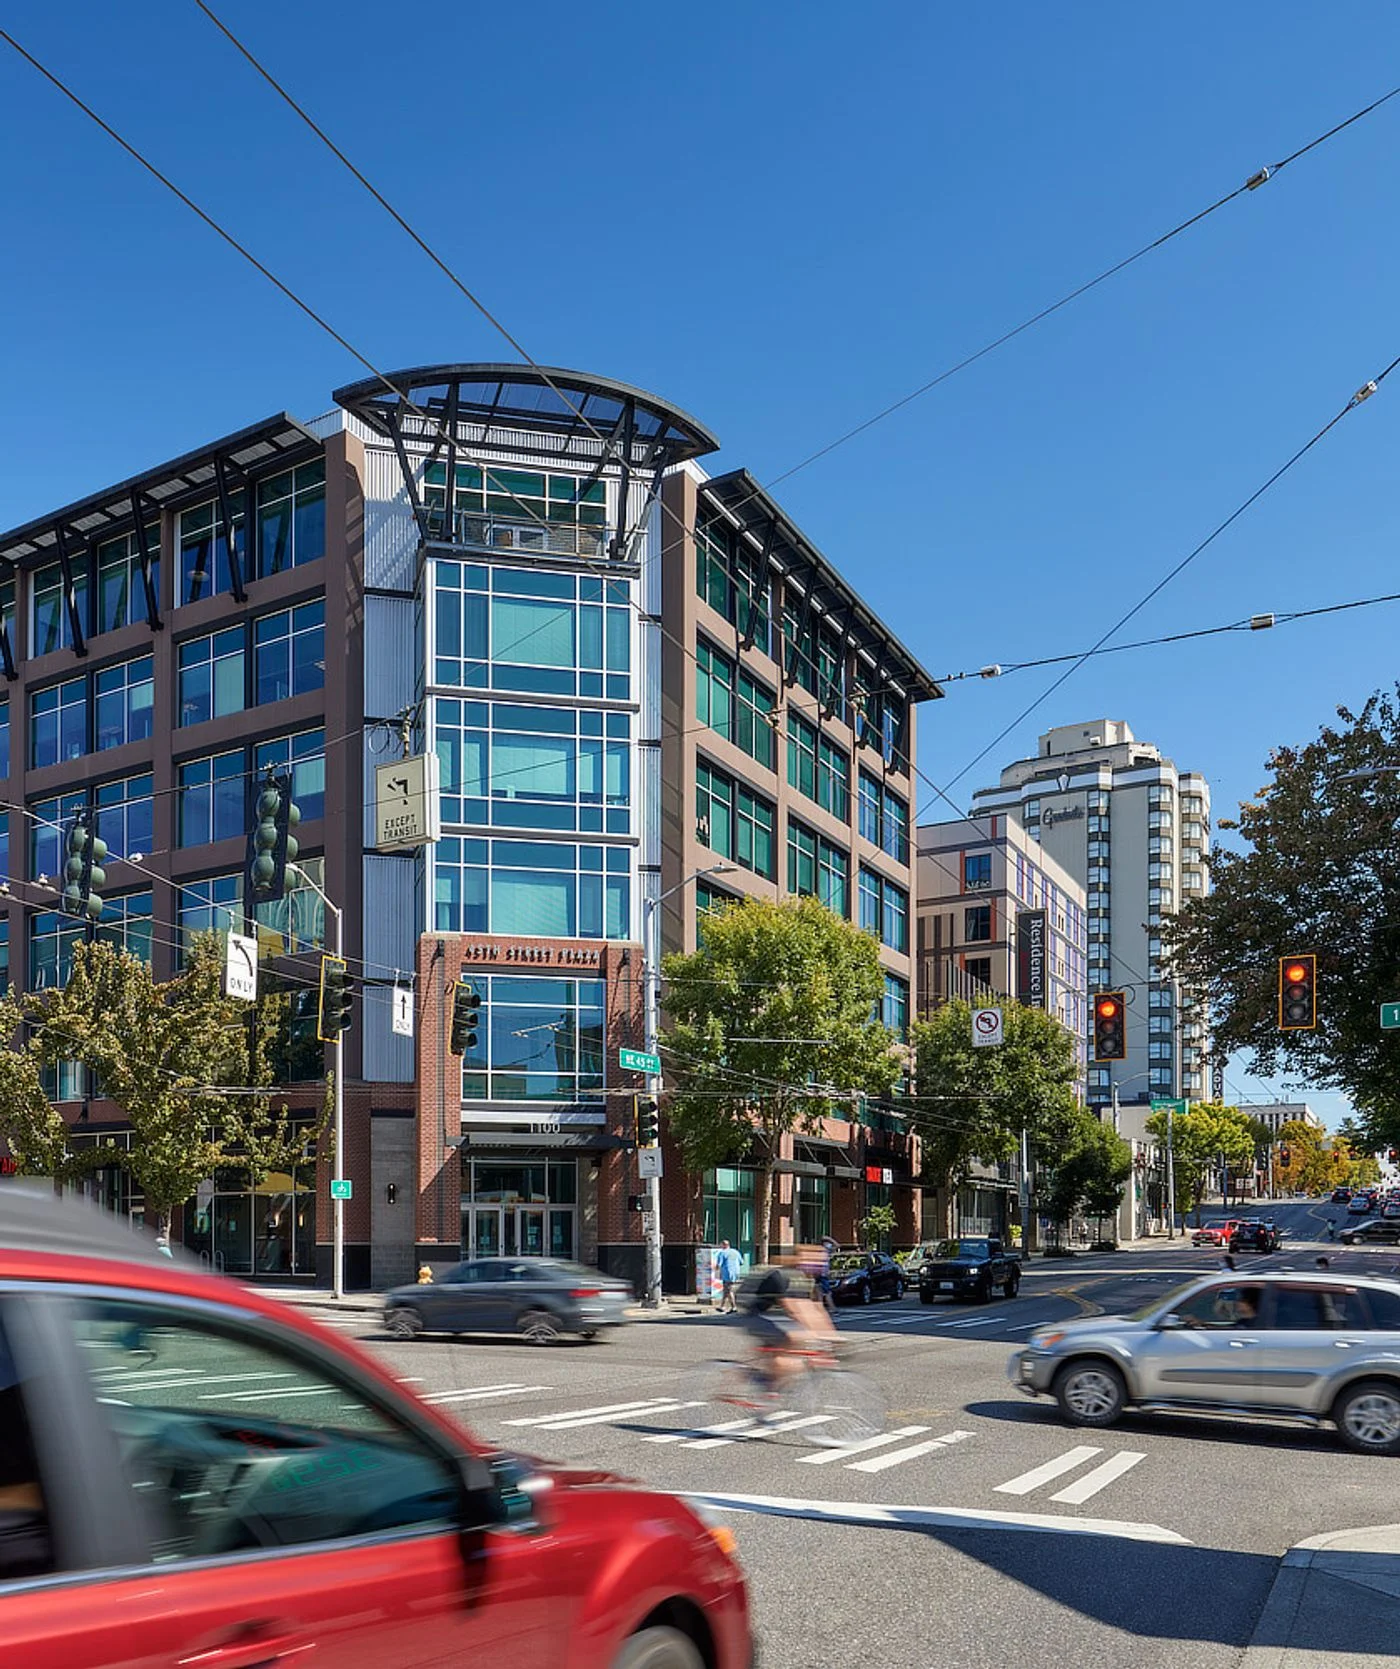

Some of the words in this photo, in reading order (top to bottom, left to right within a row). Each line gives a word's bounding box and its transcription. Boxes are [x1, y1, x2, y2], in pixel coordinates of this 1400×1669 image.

[385, 814, 415, 829] EXCEPT
[383, 824, 417, 840] TRANSIT
[465, 944, 500, 960] 45TH
[506, 945, 554, 962] STREET
[558, 947, 599, 964] PLAZA
[1031, 919, 1044, 991] Residence
[230, 977, 253, 993] ONLY
[1031, 994, 1043, 1008] In
[530, 1122, 560, 1135] 1100
